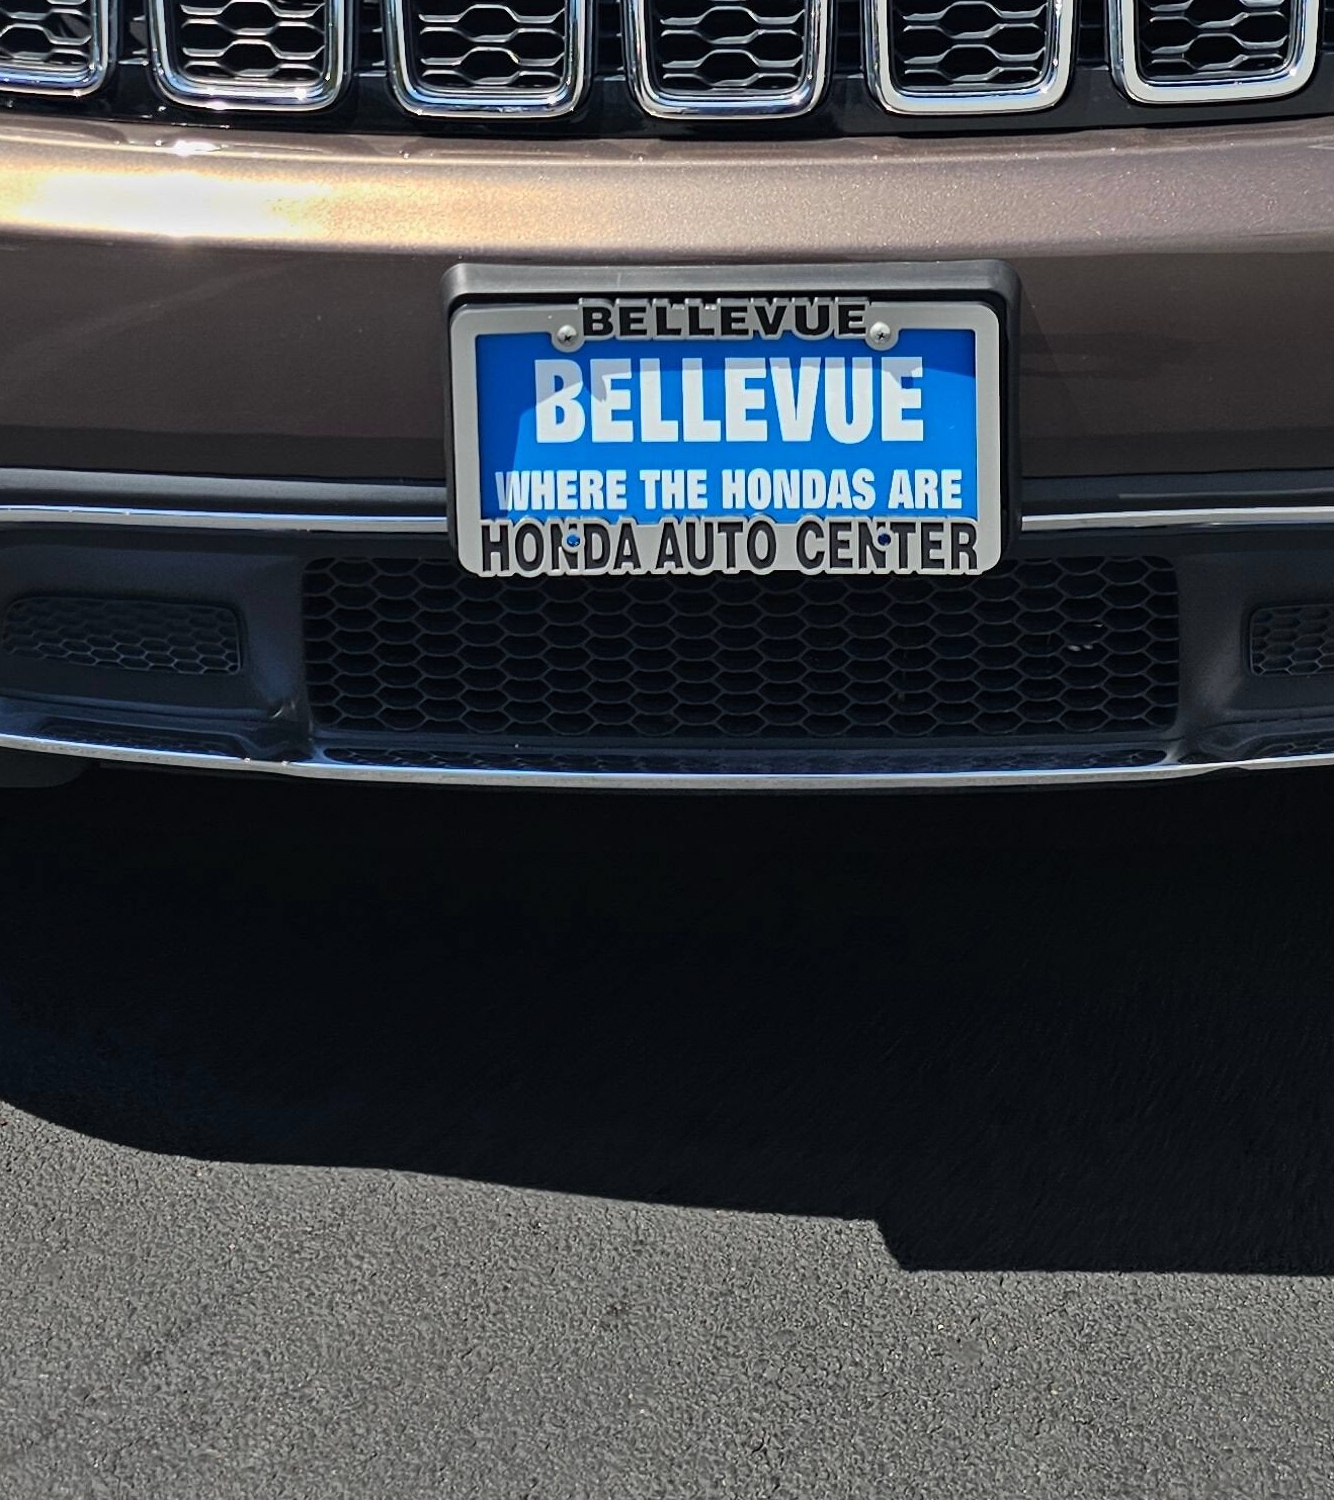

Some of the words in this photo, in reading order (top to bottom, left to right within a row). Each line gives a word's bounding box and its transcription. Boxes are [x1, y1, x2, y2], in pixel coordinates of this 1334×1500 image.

[581, 302, 868, 338] BELLEVUE
[533, 356, 925, 444] BELLEVUE
[495, 469, 628, 511] WHERE
[639, 469, 709, 510] THE
[721, 468, 877, 511] HONDAS
[888, 469, 963, 510] ARE
[480, 521, 642, 572] HONDA
[654, 520, 777, 571] AUTO
[796, 520, 979, 570] CENTER
